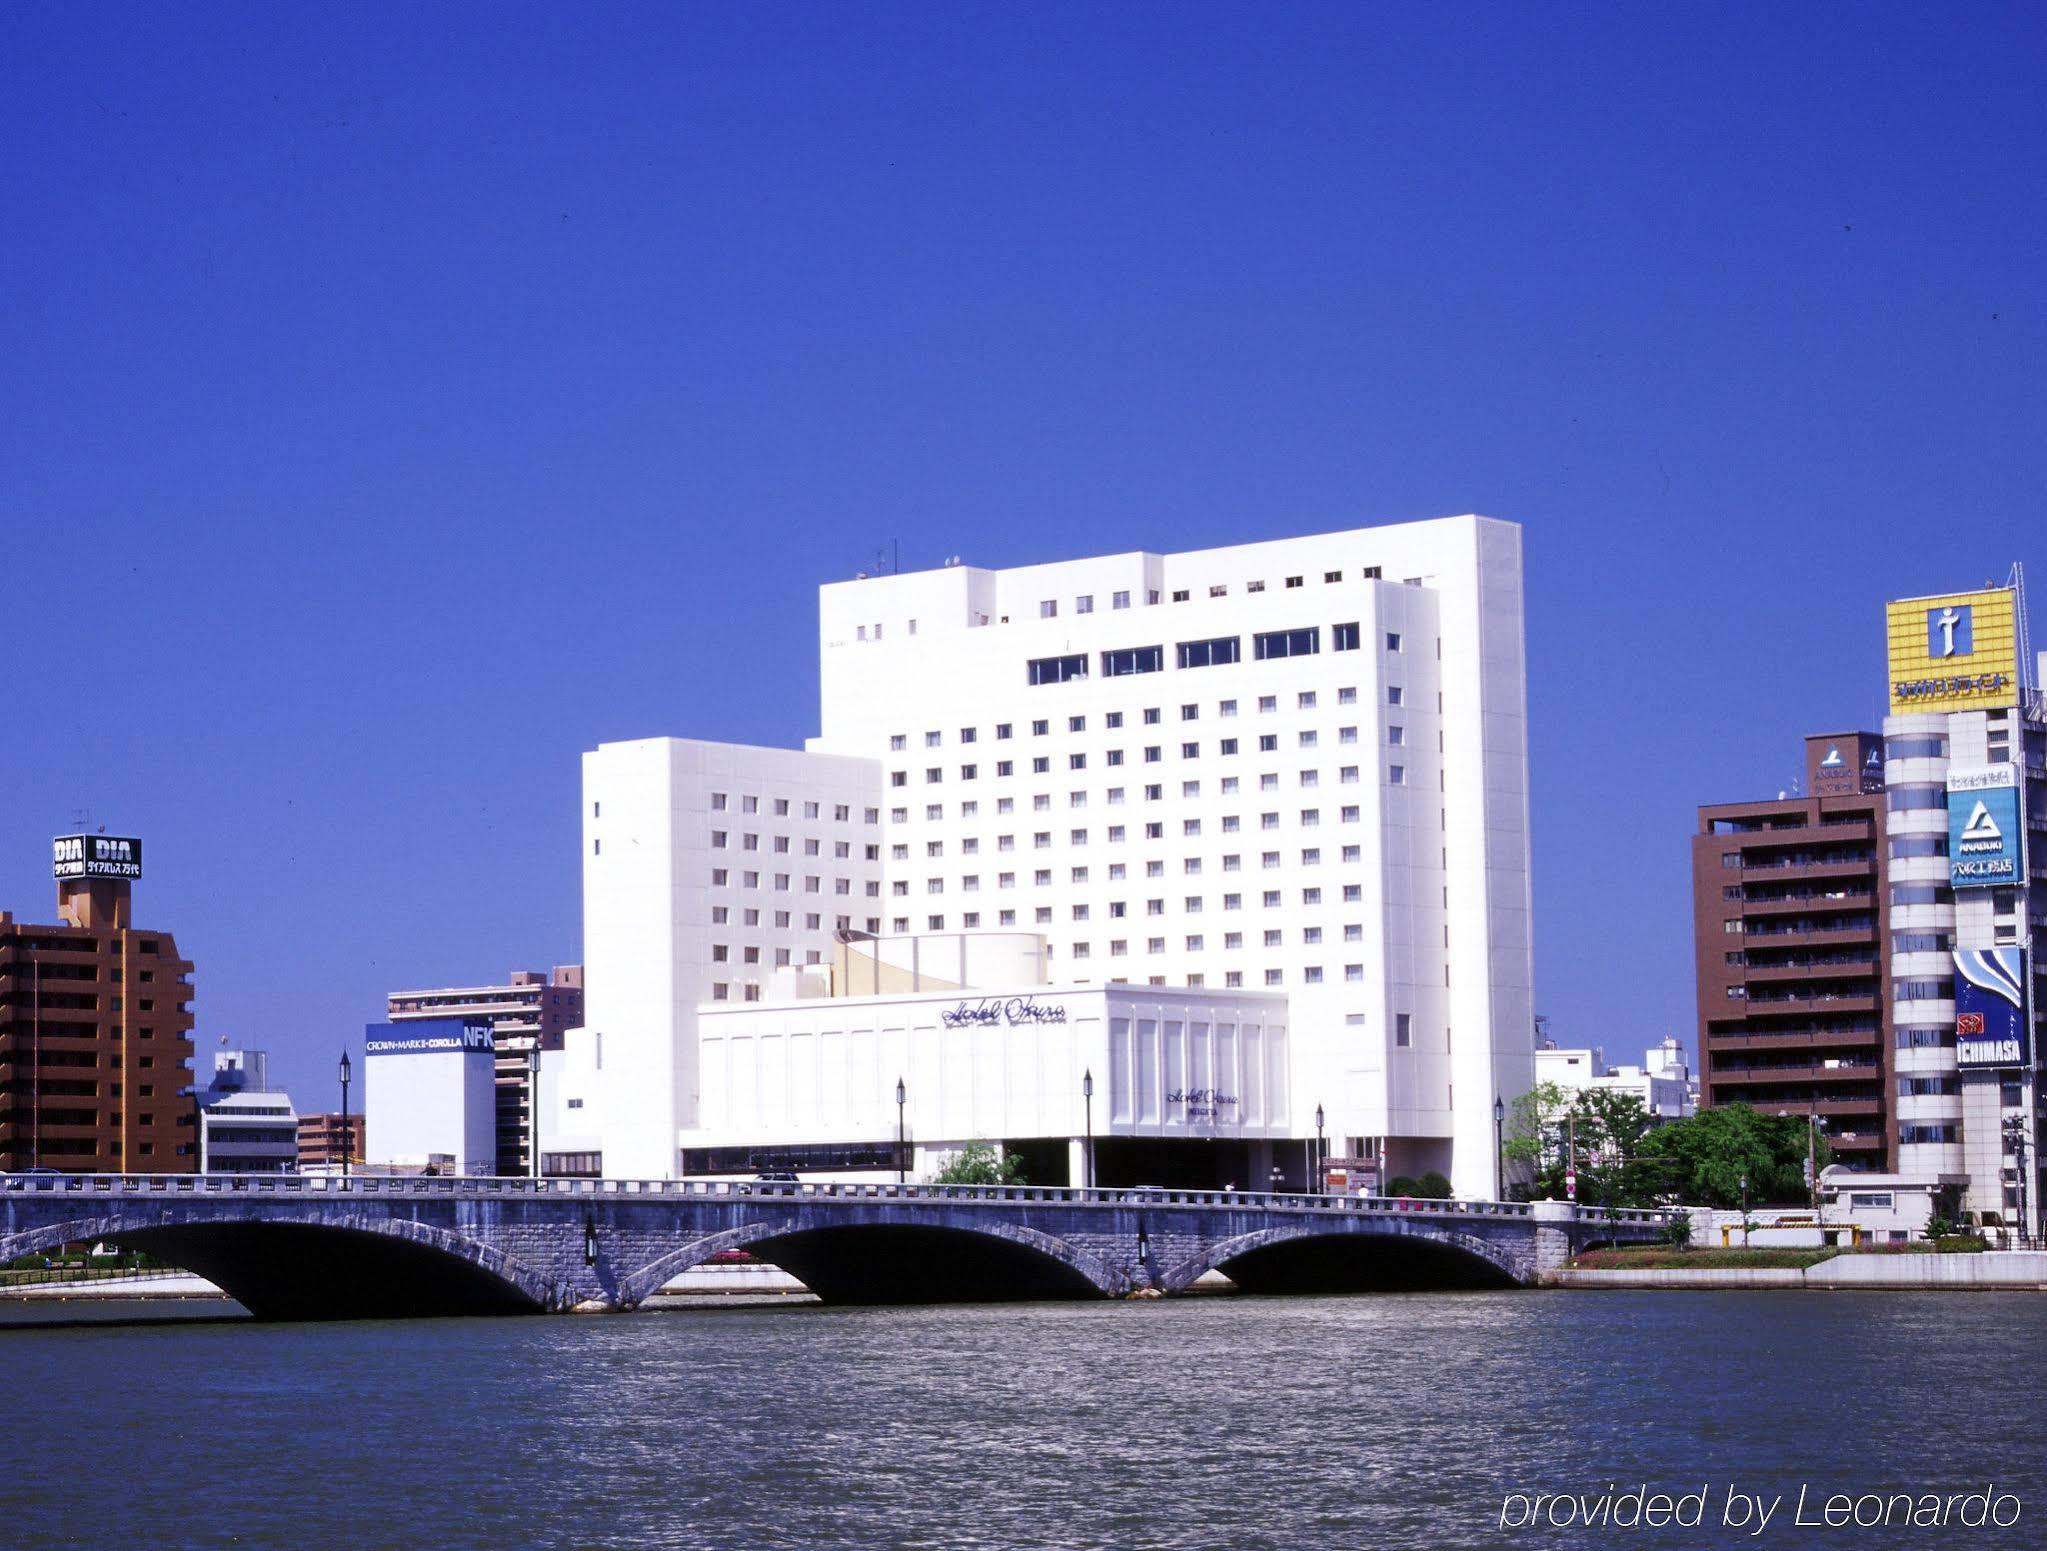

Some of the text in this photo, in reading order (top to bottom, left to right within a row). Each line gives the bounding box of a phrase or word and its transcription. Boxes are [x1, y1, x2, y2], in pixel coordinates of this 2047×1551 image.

[54, 839, 83, 861] DIA
[95, 839, 132, 860] DIA
[941, 998, 1002, 1022] Hotel
[463, 1026, 495, 1047] NFK
[1956, 1040, 2021, 1064] ICHIMASA
